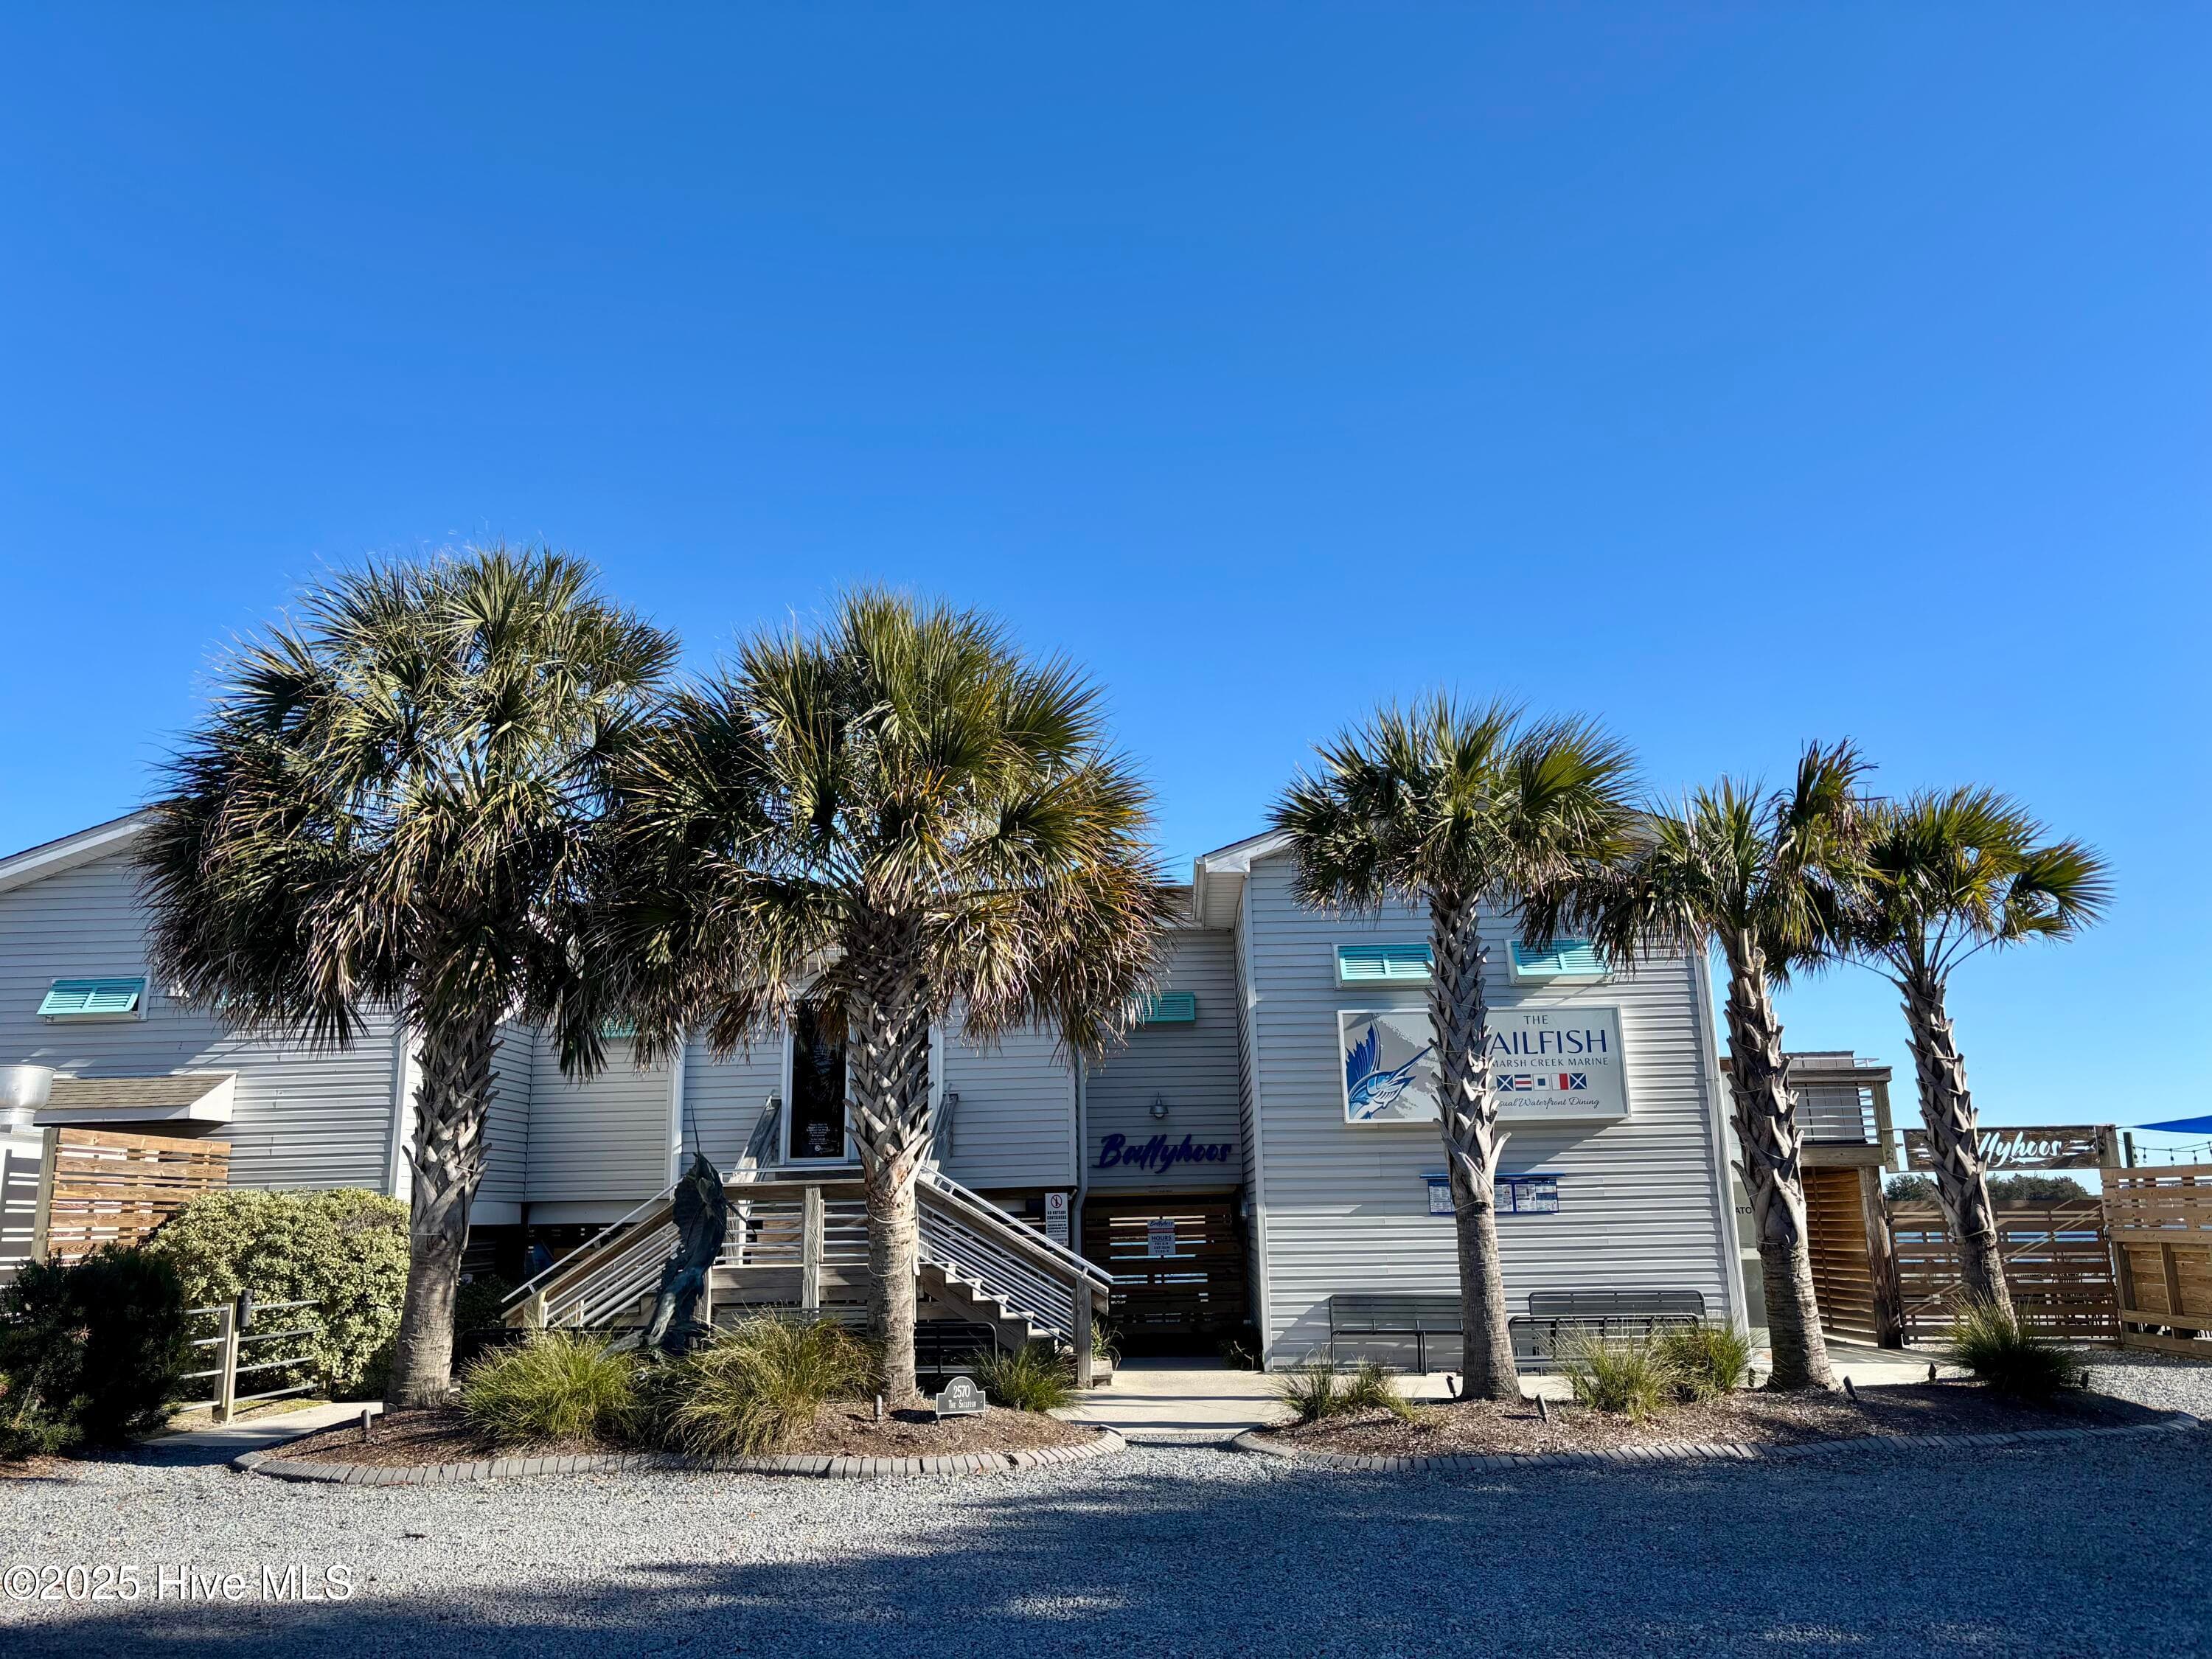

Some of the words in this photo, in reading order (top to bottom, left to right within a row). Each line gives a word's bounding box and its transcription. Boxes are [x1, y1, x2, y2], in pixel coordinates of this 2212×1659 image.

[1523, 1015, 1548, 1025] THE
[1489, 1029, 1607, 1055] AILFISH
[1531, 1058, 1564, 1067] CREEK
[1568, 1057, 1609, 1066] MARINE
[1499, 1098, 1517, 1107] sual
[1517, 1097, 1567, 1109] Waterfront
[1569, 1097, 1600, 1108] Dining
[1092, 1133, 1232, 1174] Ballyhoos
[1978, 1131, 2062, 1167] llyhoos
[953, 1385, 970, 1398] 2570
